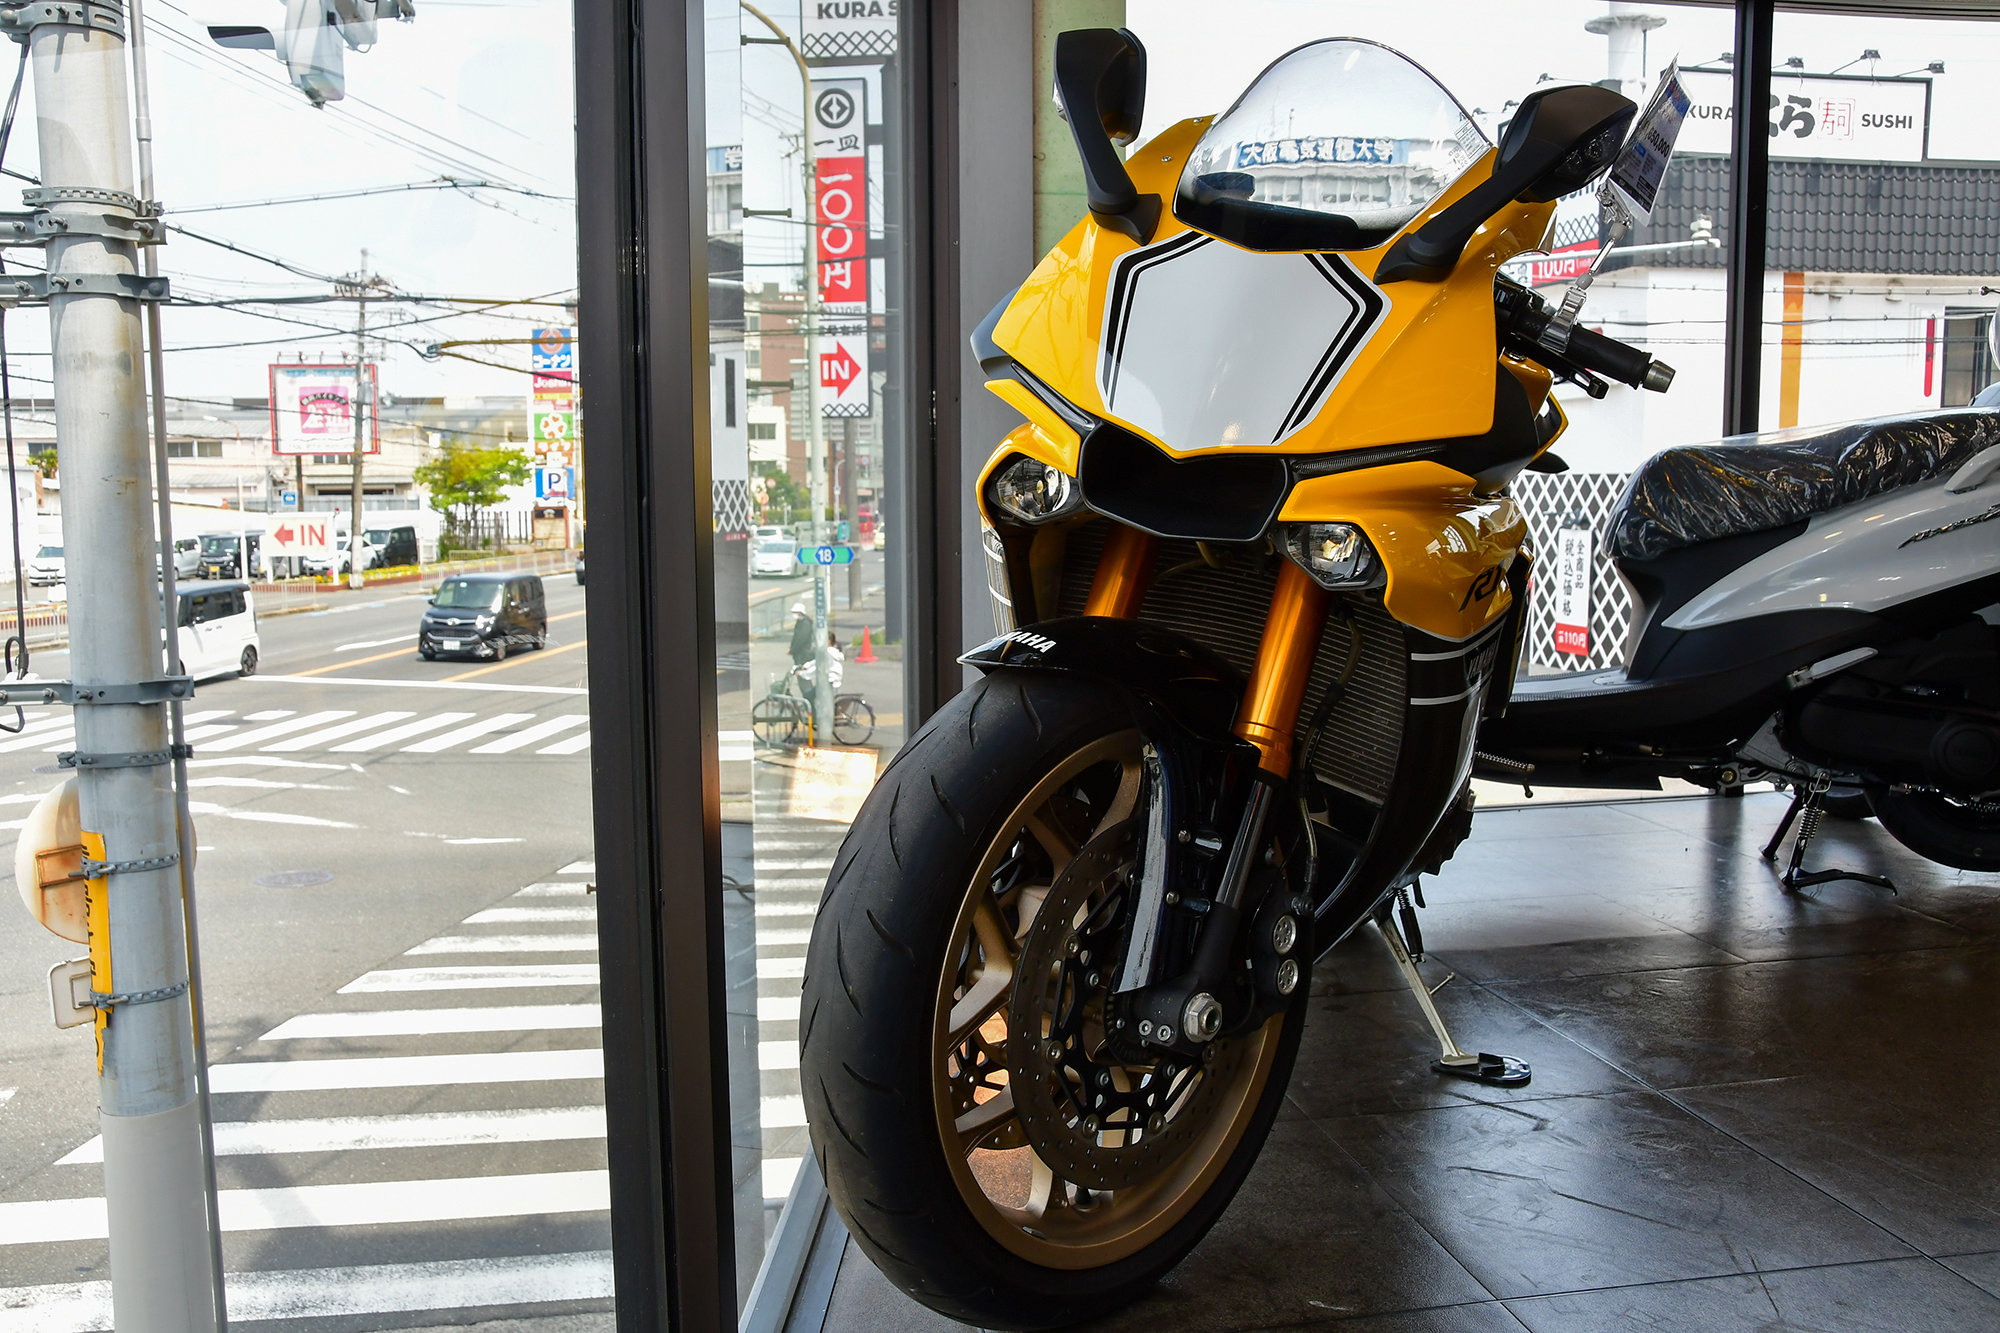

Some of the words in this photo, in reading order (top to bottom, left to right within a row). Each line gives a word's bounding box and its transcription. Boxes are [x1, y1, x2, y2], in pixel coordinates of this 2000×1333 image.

[817, 1, 884, 20] KURA
[1861, 113, 1913, 129] SUSHI
[822, 359, 850, 380] IN
[301, 524, 325, 546] IN
[818, 548, 832, 563] 18
